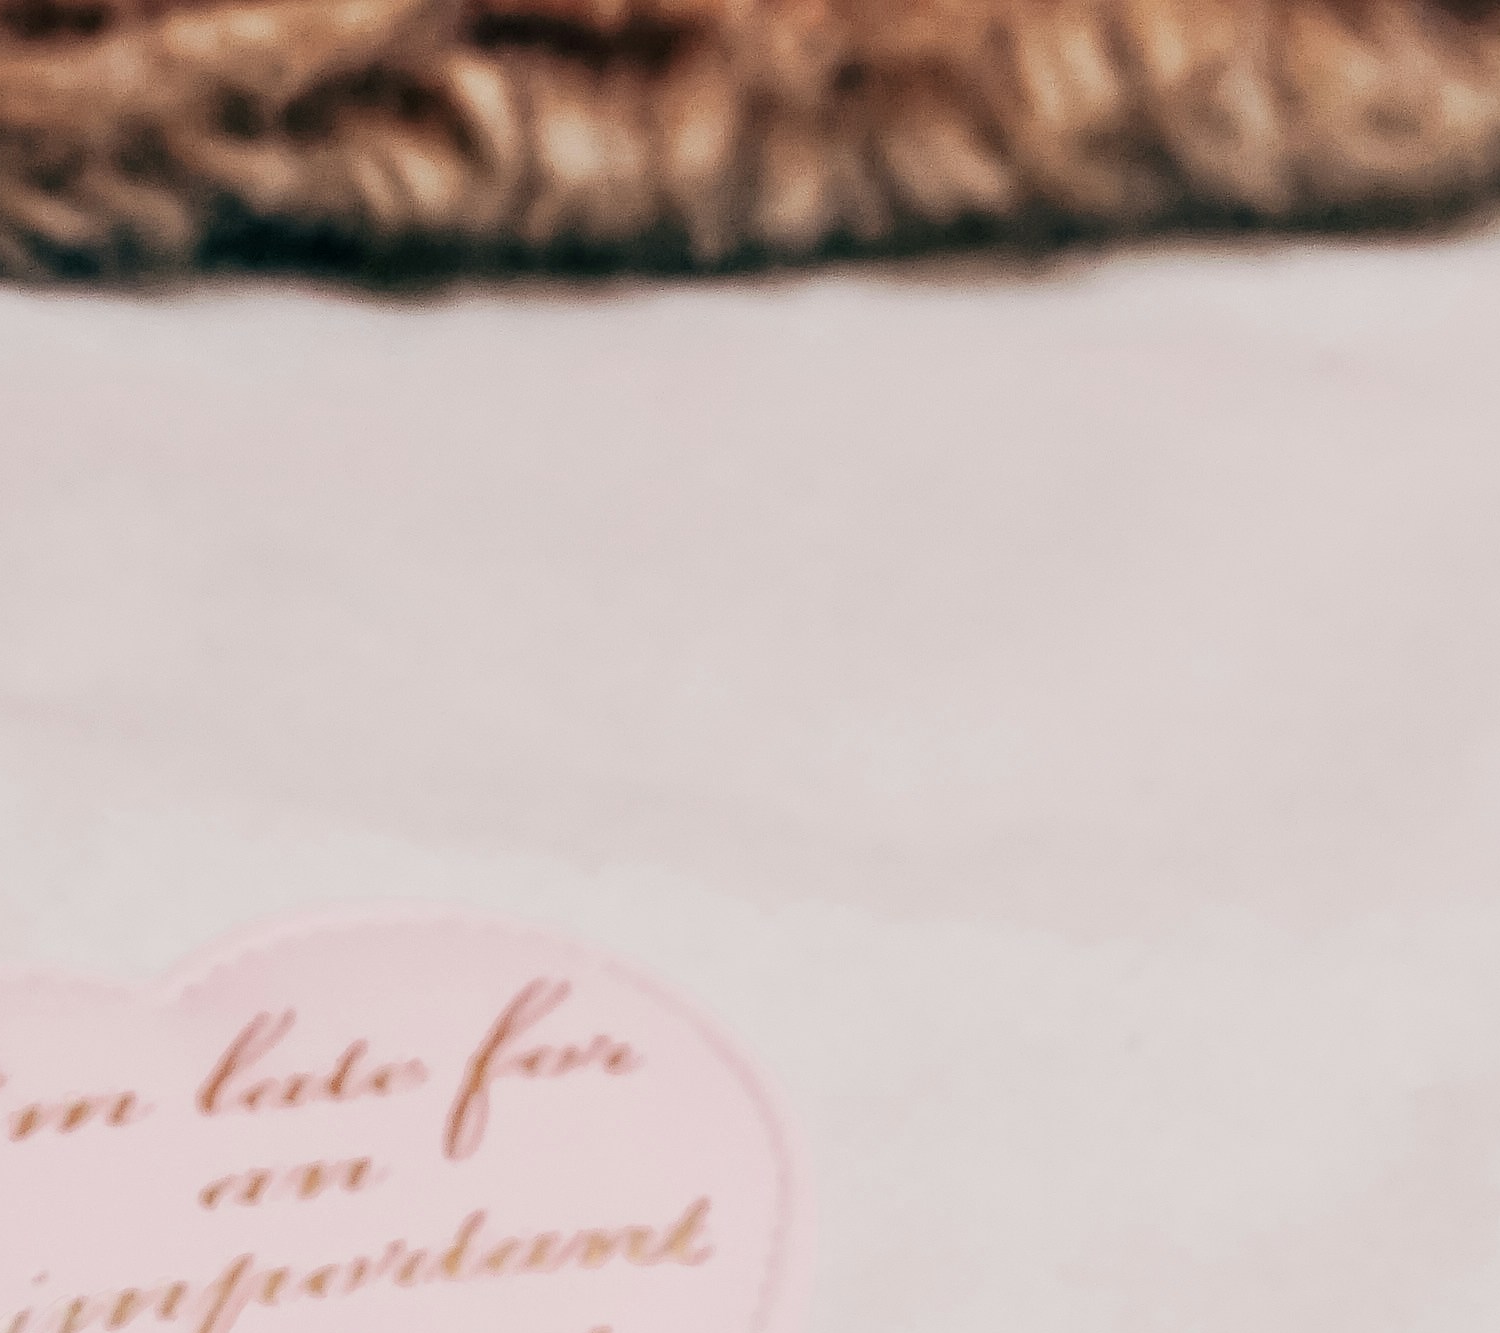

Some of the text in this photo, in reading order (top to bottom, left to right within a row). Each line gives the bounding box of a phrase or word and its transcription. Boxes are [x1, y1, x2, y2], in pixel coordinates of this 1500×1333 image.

[197, 1008, 428, 1115] late
[442, 977, 644, 1162] for
[198, 1155, 388, 1209] an
